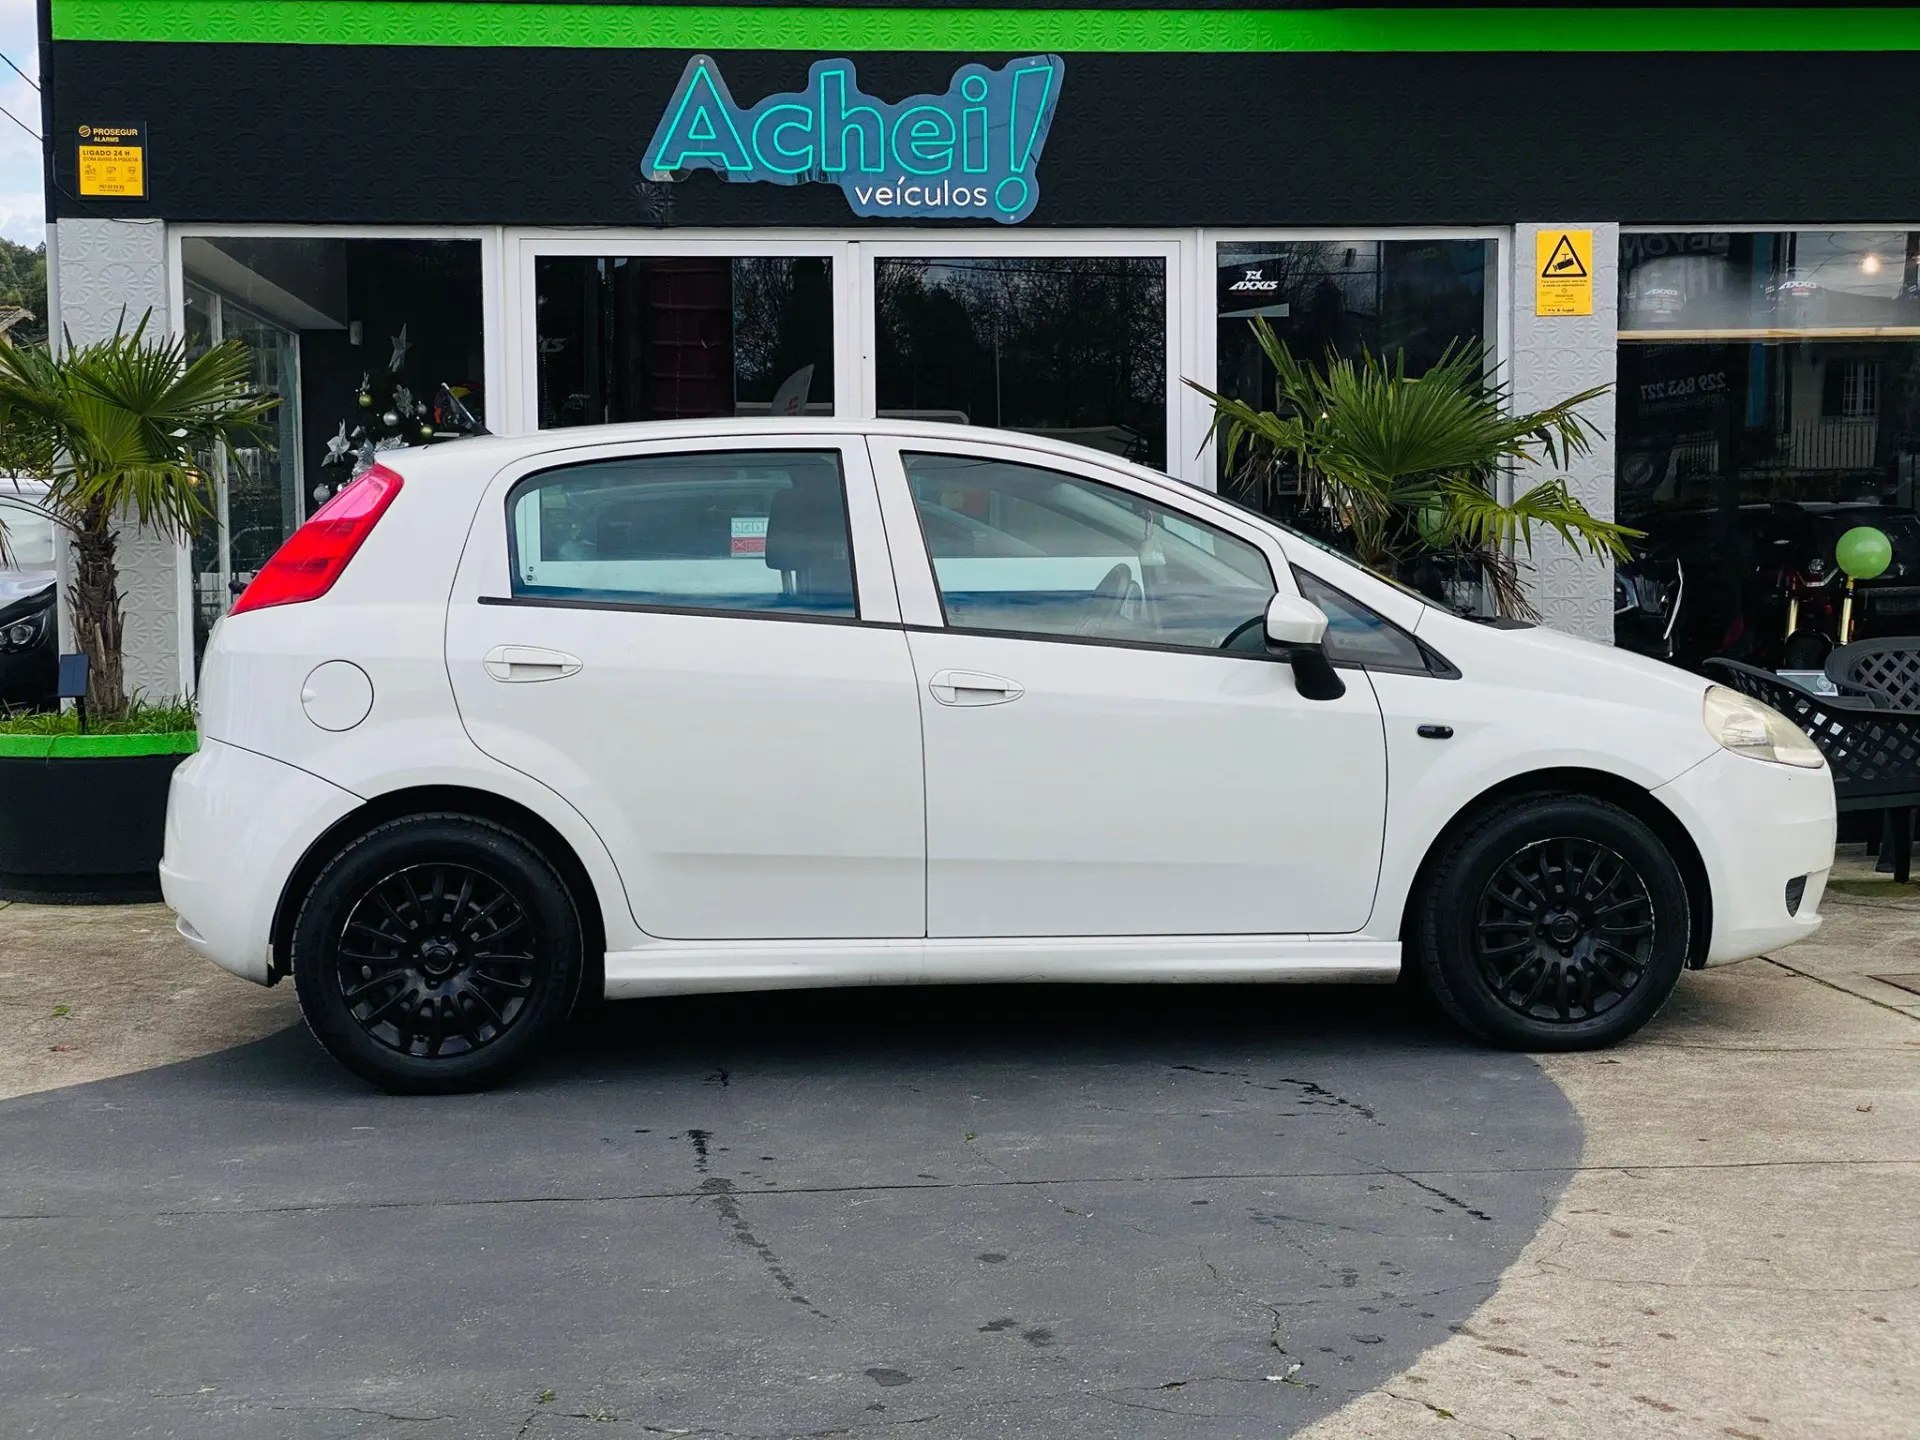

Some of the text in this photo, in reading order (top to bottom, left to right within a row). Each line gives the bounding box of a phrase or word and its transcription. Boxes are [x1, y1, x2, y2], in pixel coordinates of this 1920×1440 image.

[93, 128, 138, 136] PROSEGUR
[652, 65, 1054, 212] Achei!
[855, 176, 988, 206] veículos
[1228, 280, 1279, 291] AXXIS
